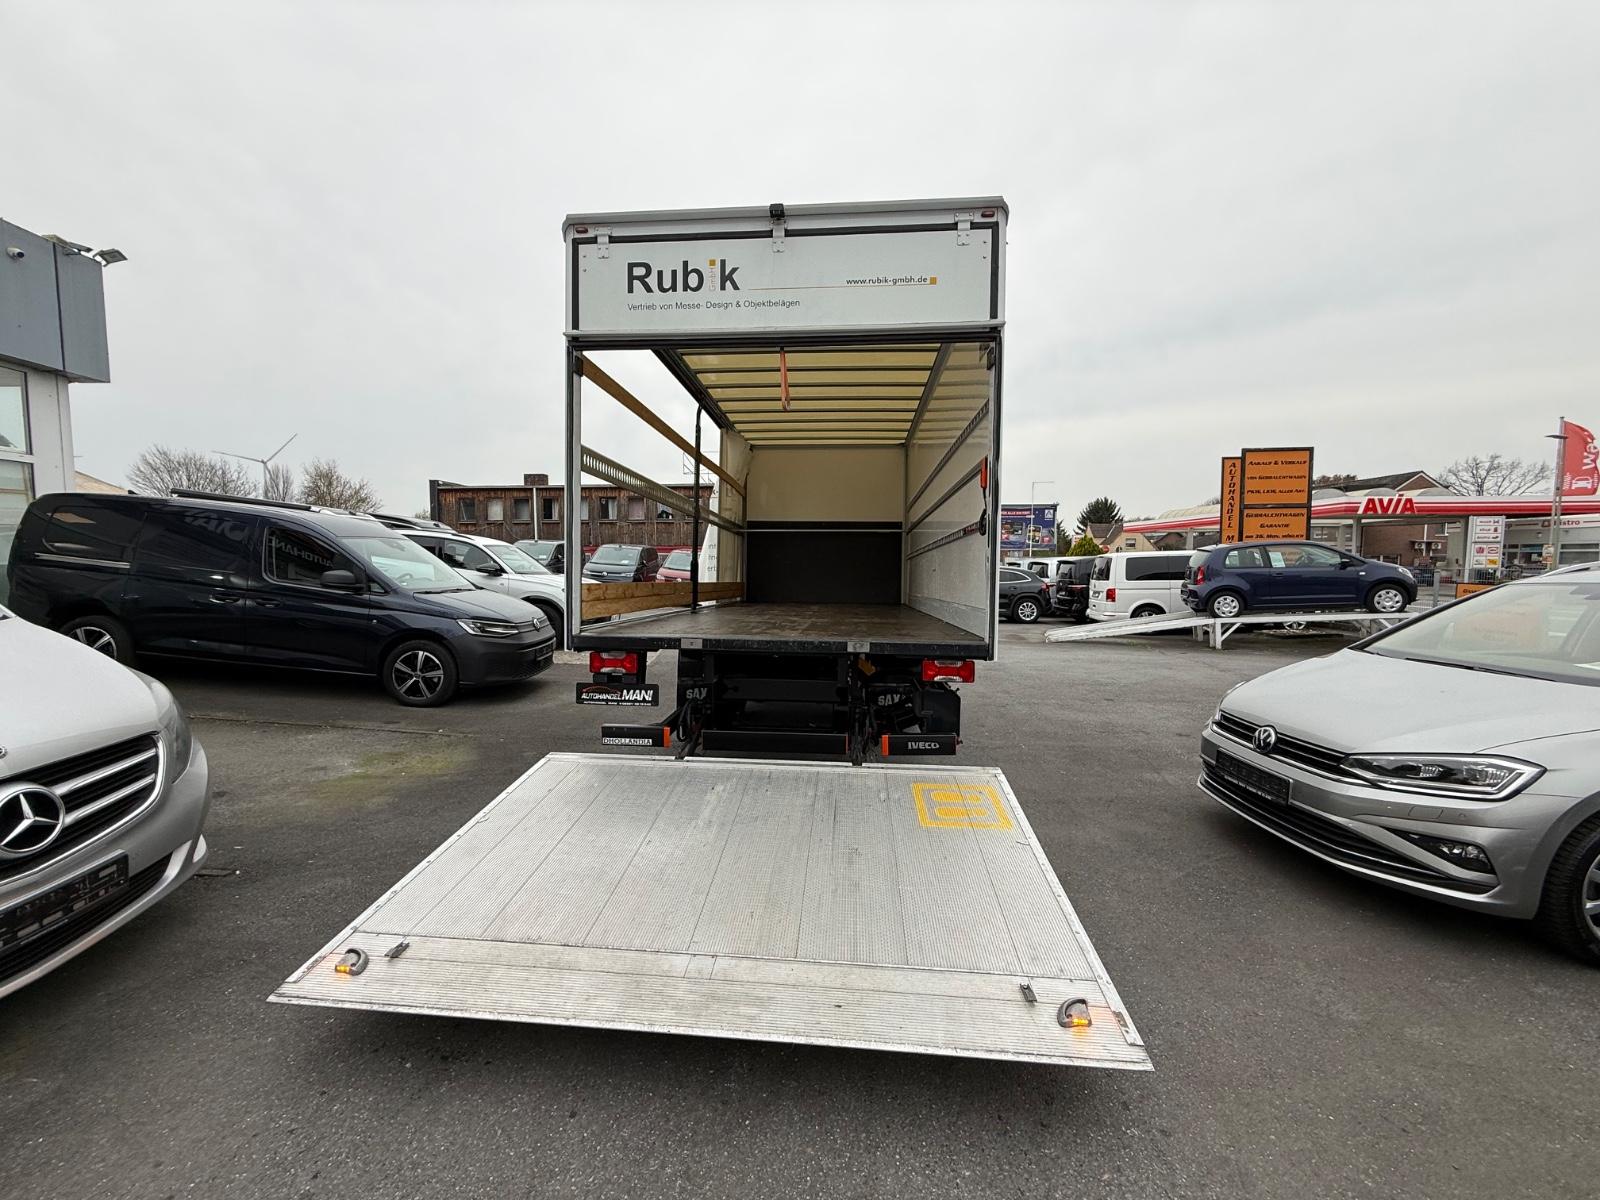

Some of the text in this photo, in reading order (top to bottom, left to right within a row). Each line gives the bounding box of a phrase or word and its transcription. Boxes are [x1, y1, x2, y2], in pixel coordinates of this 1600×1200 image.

[626, 258, 741, 294] Rubik
[846, 275, 928, 285] www.rubik-gmbh.de
[627, 303, 657, 311] Vertrieb
[705, 300, 733, 310] Design
[735, 300, 741, 308] &
[743, 299, 801, 309] Objektbelägen
[1226, 462, 1237, 529] AUTOHANDEL
[1361, 493, 1417, 515] AVIA
[581, 689, 654, 701] AUTOHANDEL MANI
[603, 737, 652, 745] DHOLLANDIA
[907, 741, 940, 750] IVECO
